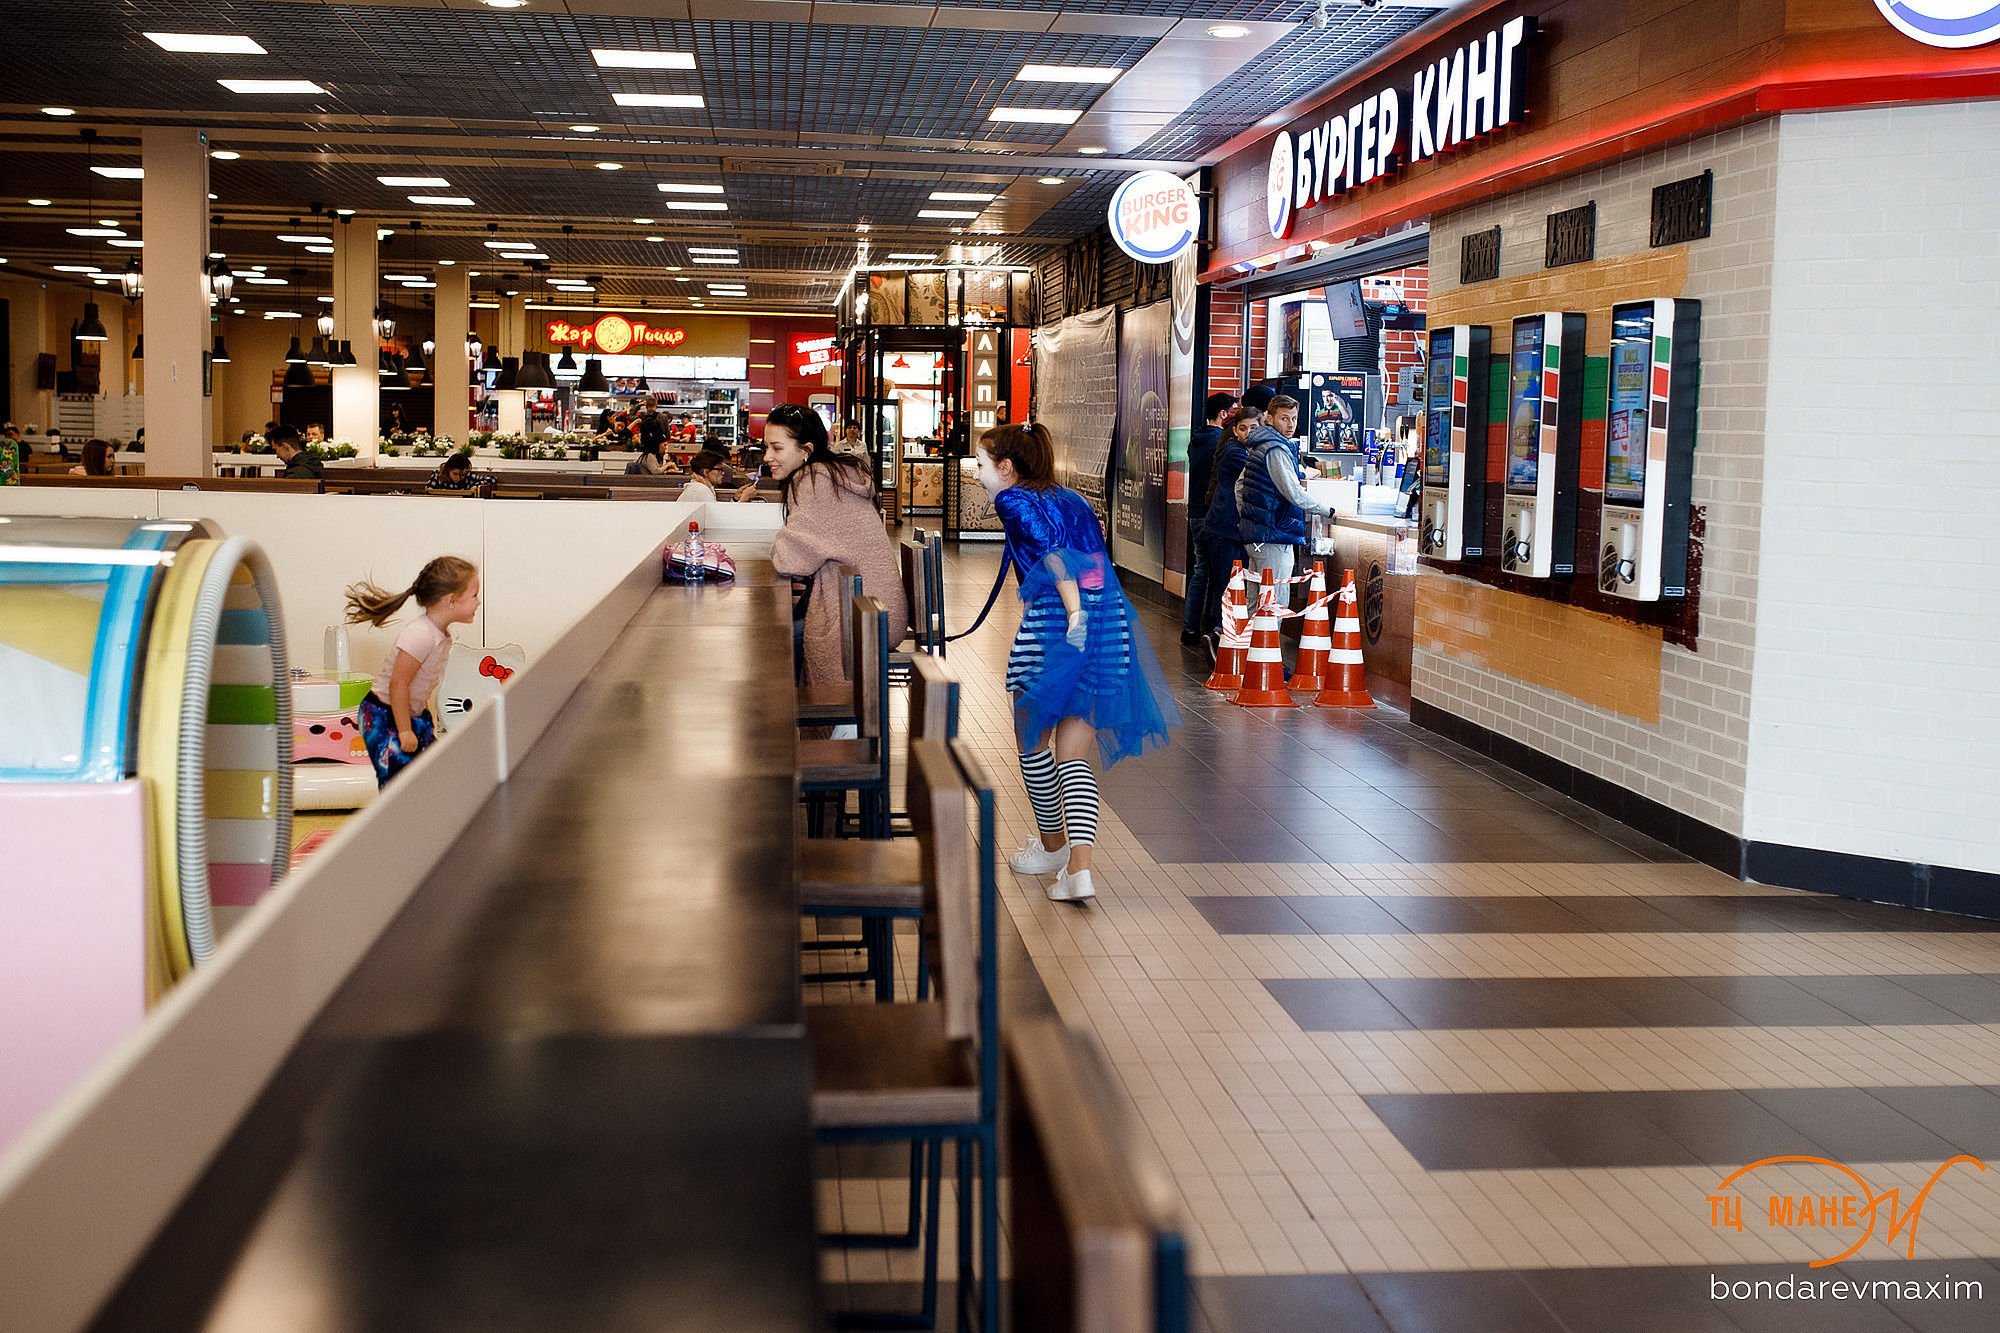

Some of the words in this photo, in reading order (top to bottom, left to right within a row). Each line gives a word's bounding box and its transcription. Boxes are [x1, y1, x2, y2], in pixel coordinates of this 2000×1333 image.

[1296, 88, 1398, 209] БУРГЕР
[1412, 16, 1524, 163] КИНГ
[1122, 188, 1186, 217] BURGER
[1125, 203, 1188, 239] KING
[1554, 225, 1592, 264] ЗАКАЗ
[1467, 247, 1498, 281] ЗАКАЗ
[549, 323, 592, 347] Жар
[633, 324, 684, 345] Пицца
[974, 333, 995, 428] ЛАПШ
